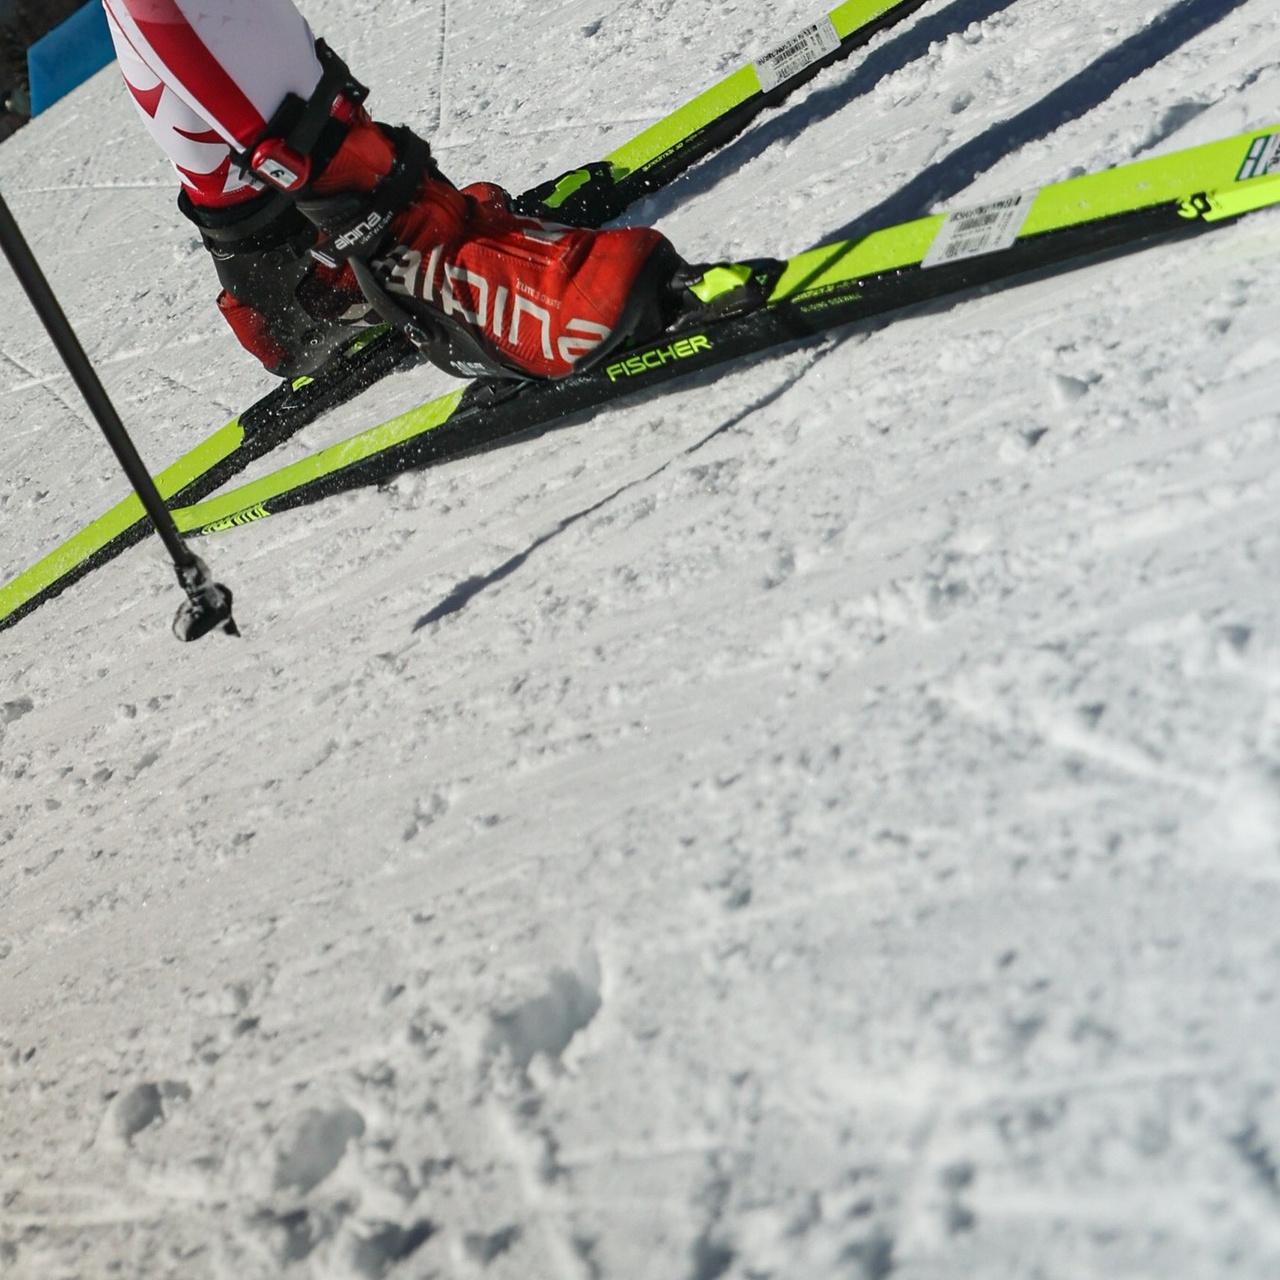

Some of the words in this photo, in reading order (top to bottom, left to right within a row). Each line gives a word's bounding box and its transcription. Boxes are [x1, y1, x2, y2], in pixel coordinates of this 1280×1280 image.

[334, 211, 381, 251] alpina
[371, 243, 612, 364] alpina
[606, 335, 713, 382] FISCHER
